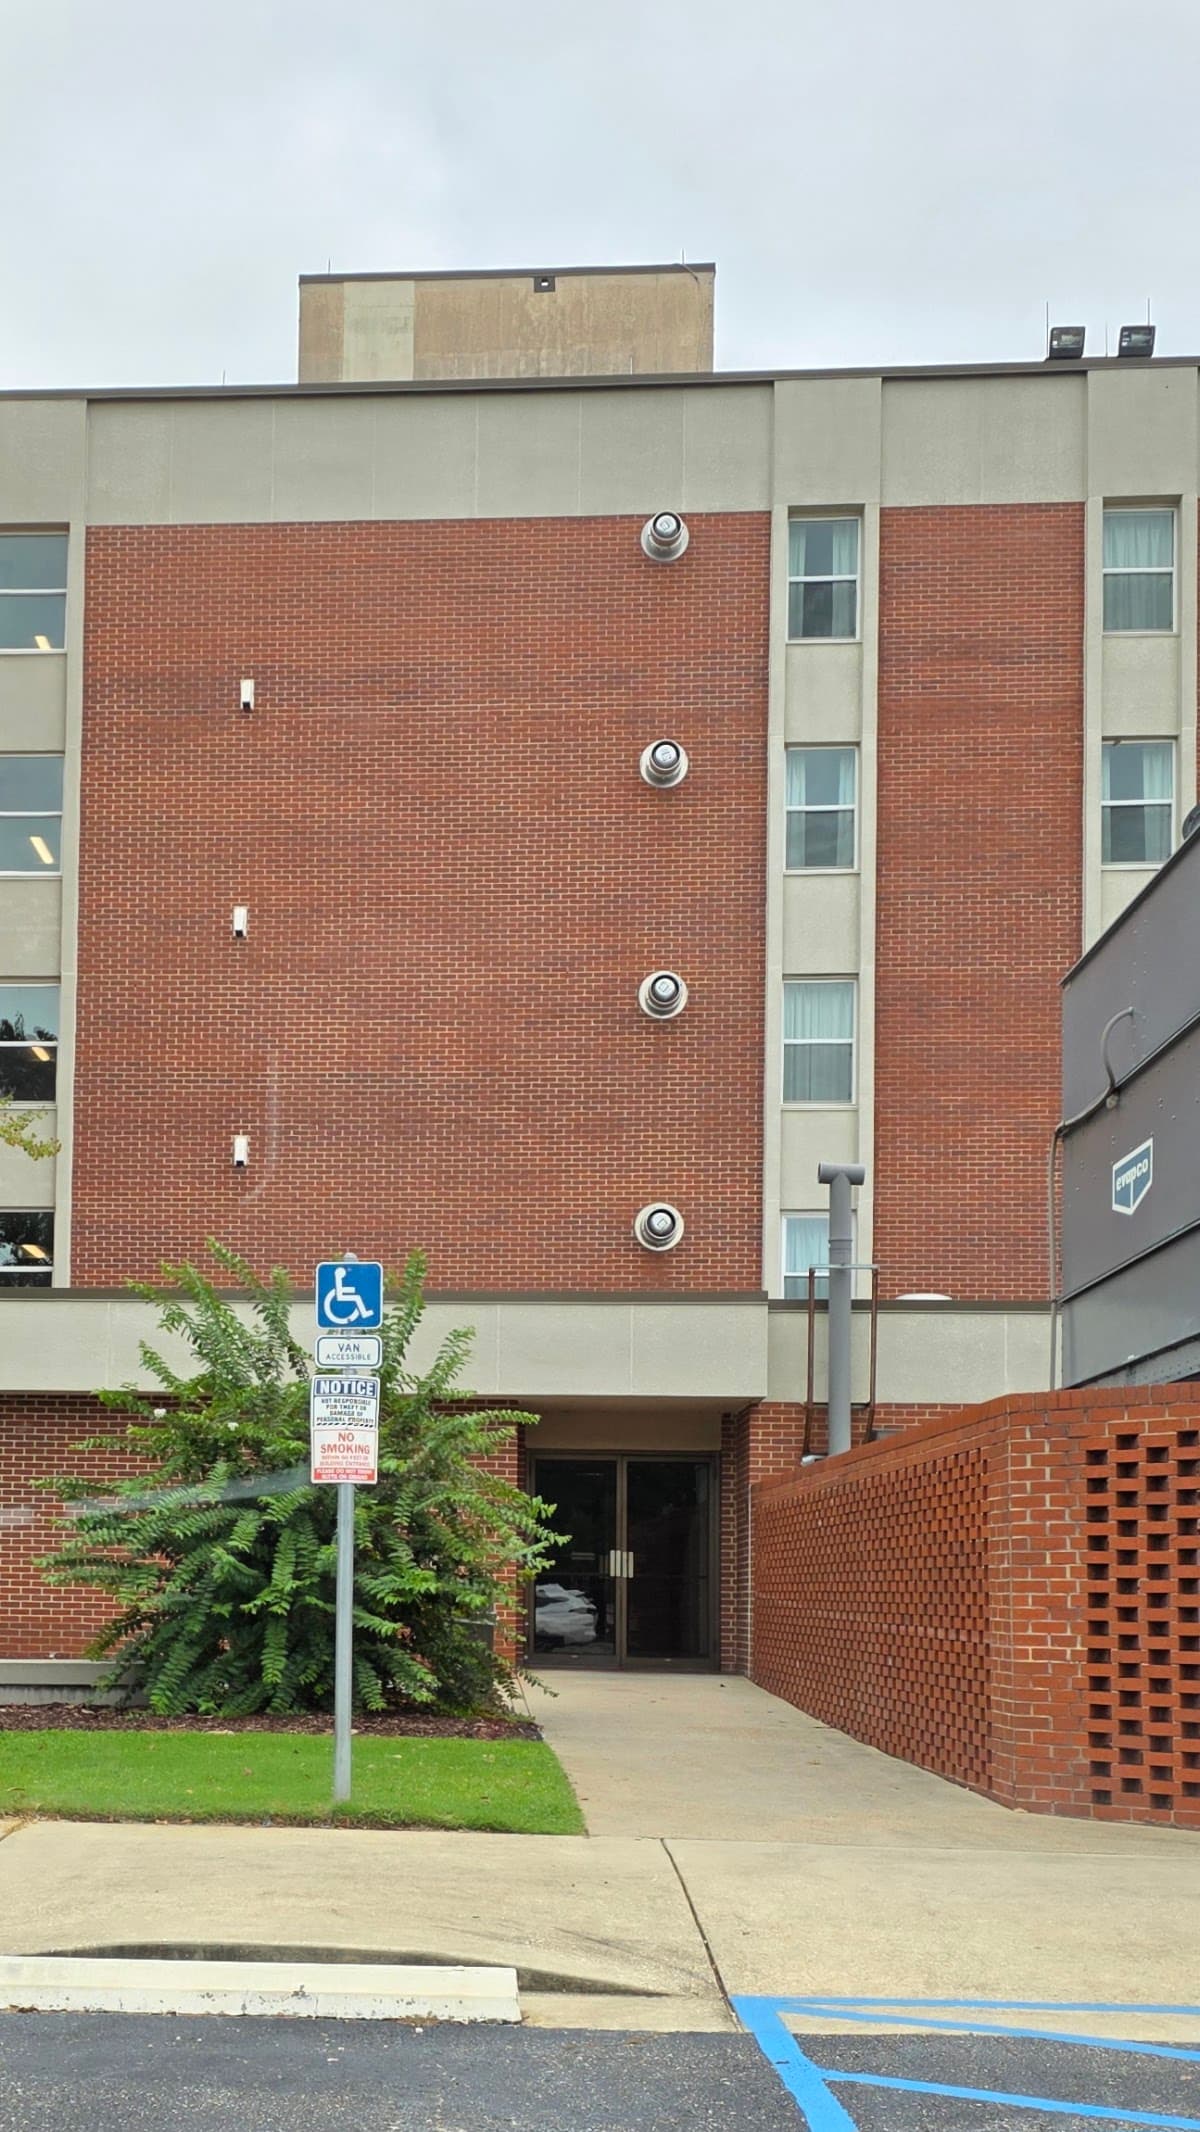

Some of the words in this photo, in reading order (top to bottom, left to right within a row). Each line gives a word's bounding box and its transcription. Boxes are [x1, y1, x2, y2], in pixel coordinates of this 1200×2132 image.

[337, 1343, 361, 1353] VAN
[326, 1353, 371, 1361] ACCESSIBLE
[319, 1380, 374, 1396] NOTICE
[337, 1432, 355, 1442] NO
[320, 1443, 370, 1454] SMOKING
